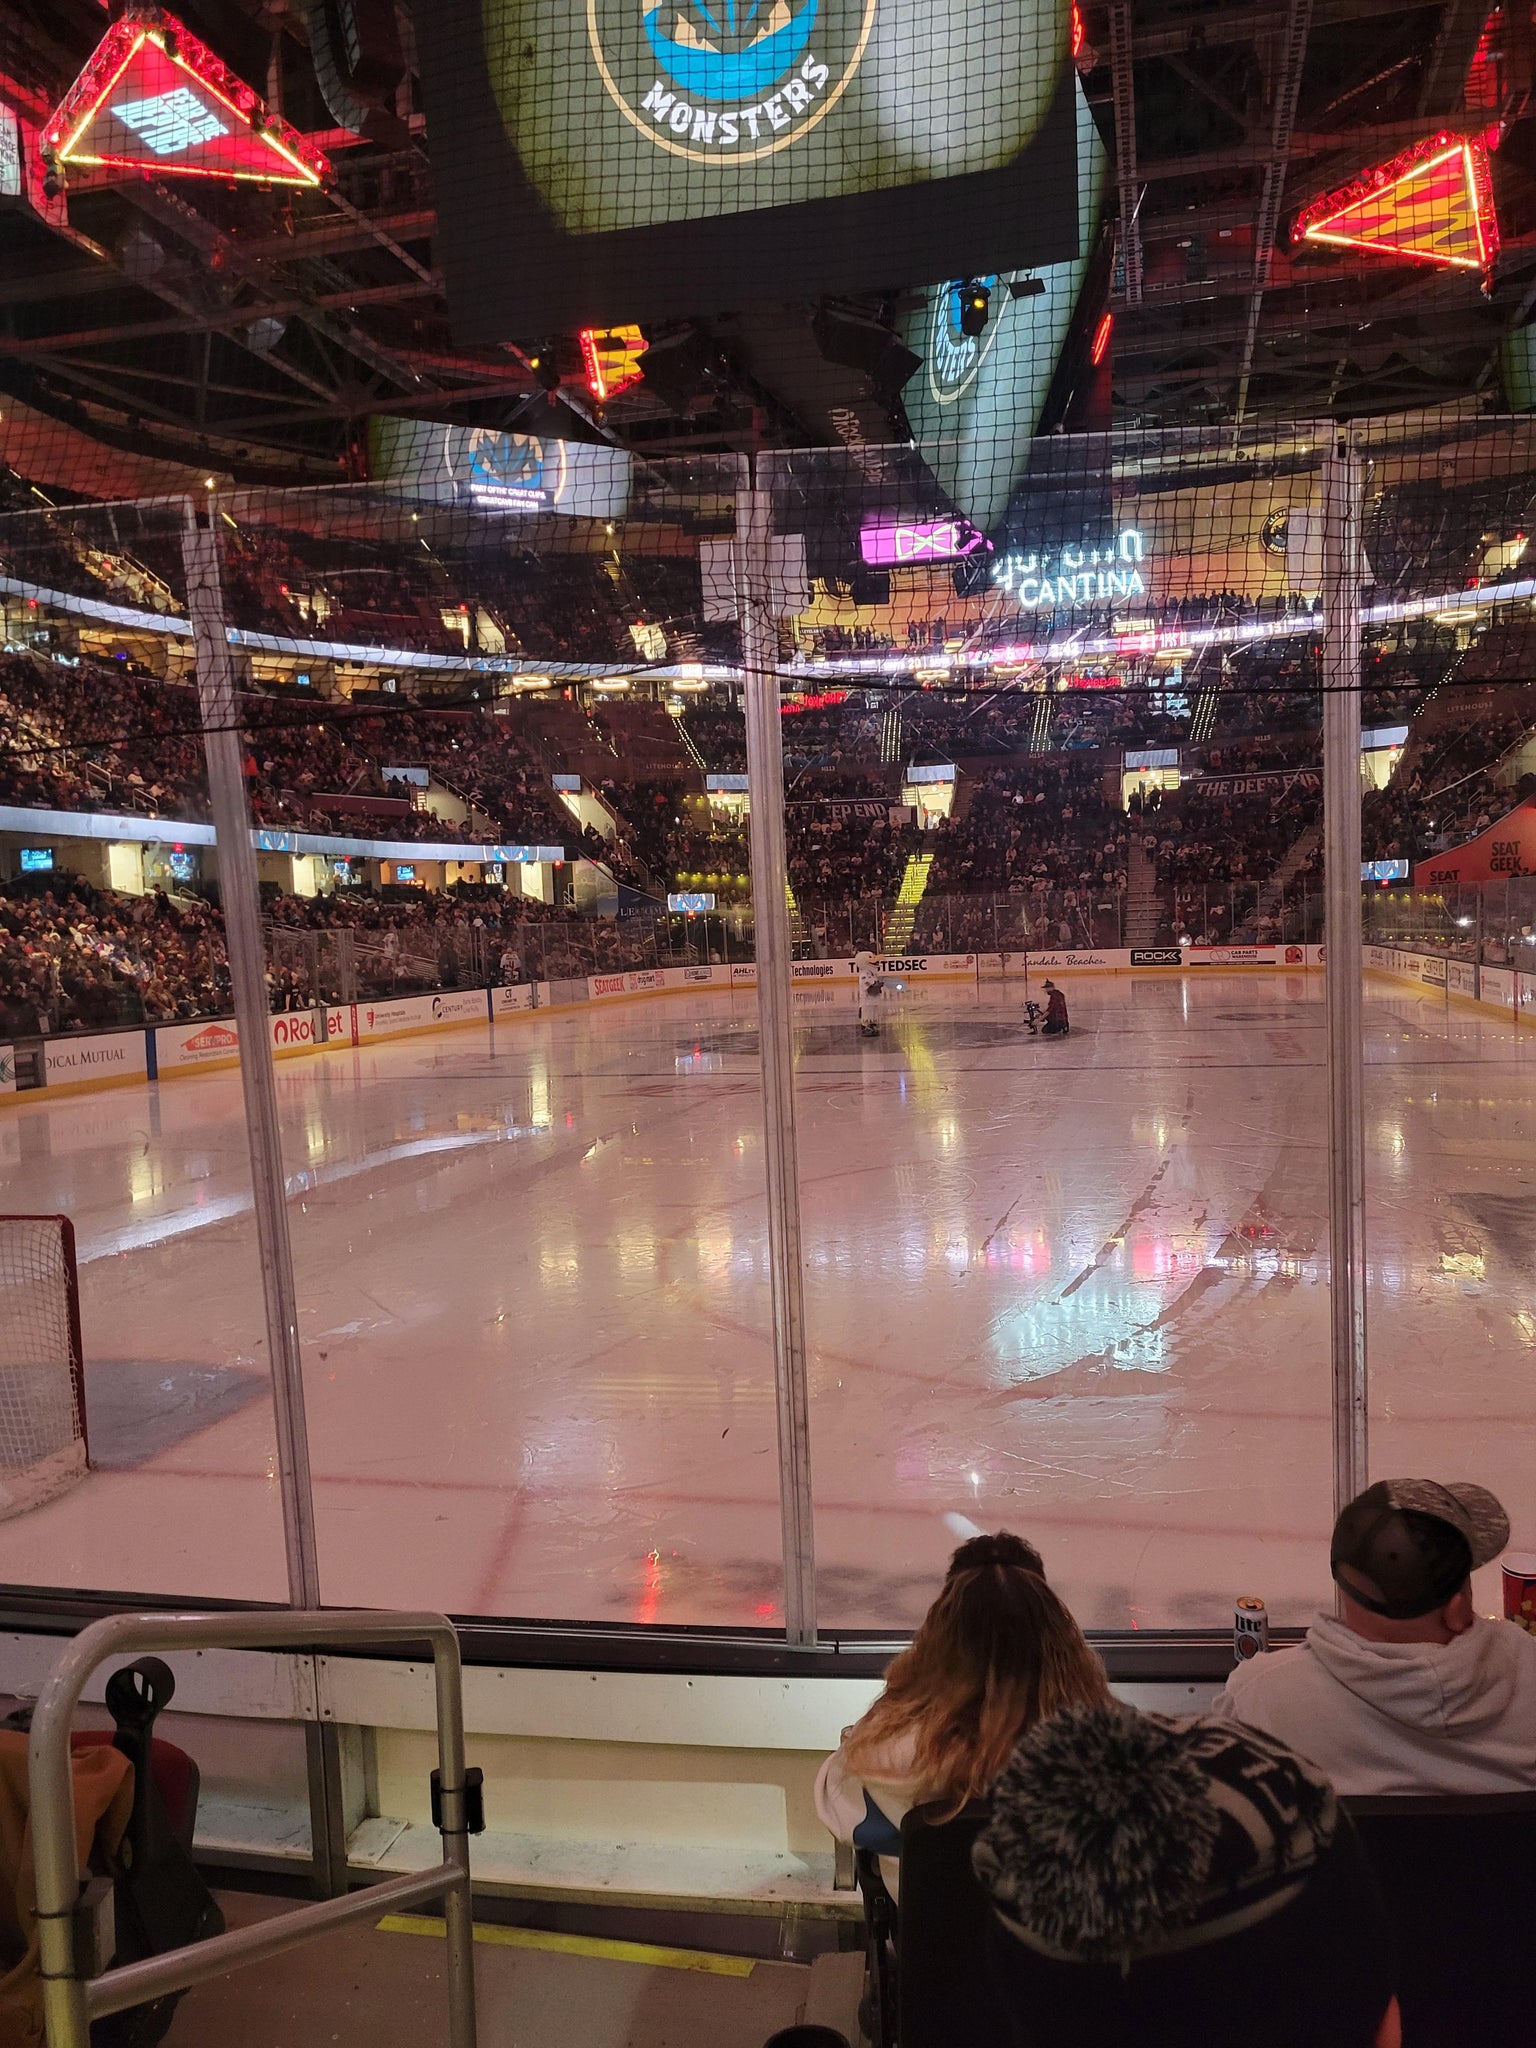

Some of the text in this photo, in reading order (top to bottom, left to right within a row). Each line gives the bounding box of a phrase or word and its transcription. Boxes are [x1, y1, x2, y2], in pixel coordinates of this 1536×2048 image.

[640, 54, 829, 145] MONSTERS
[1018, 568, 1146, 608] CANTINA
[908, 657, 921, 669] 20
[1196, 781, 1231, 797] THE
[854, 802, 887, 817] END
[1491, 840, 1521, 856] SEAT
[1490, 857, 1522, 872] GEEK
[1430, 869, 1460, 882] SEAT
[791, 964, 834, 978] Technologies
[594, 976, 625, 995] SEATGEEK
[193, 1033, 233, 1048] SERVPRO
[80, 1048, 126, 1064] MUTUAL
[1235, 1613, 1262, 1633] Lite
